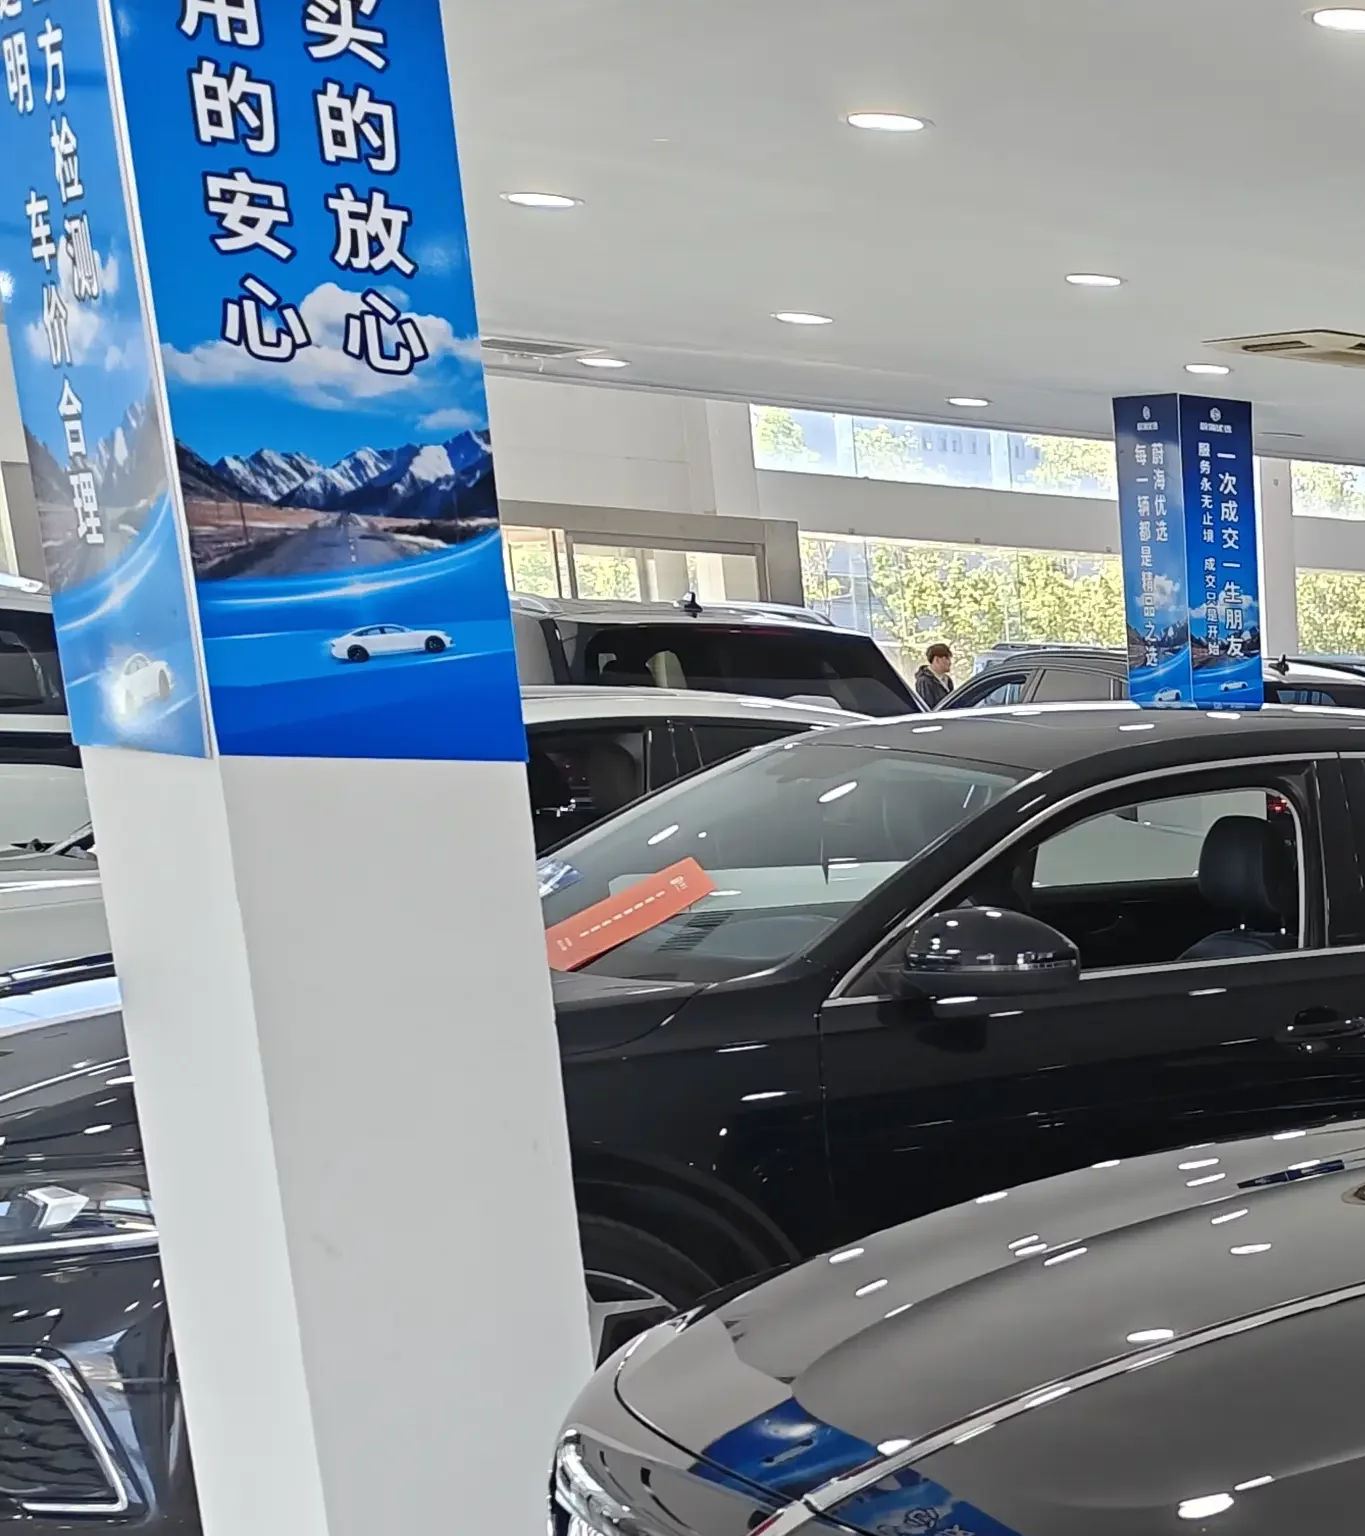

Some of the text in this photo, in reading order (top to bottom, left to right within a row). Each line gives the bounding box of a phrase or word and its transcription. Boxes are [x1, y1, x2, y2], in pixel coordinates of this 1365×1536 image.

[33, 0, 98, 299] 方检测
[26, 187, 105, 545] 车价合理
[1134, 443, 1158, 667] 每一辆都是精品之选
[1151, 442, 1168, 542] 蔚海优选
[1217, 451, 1244, 658] 一次成交一生朋友
